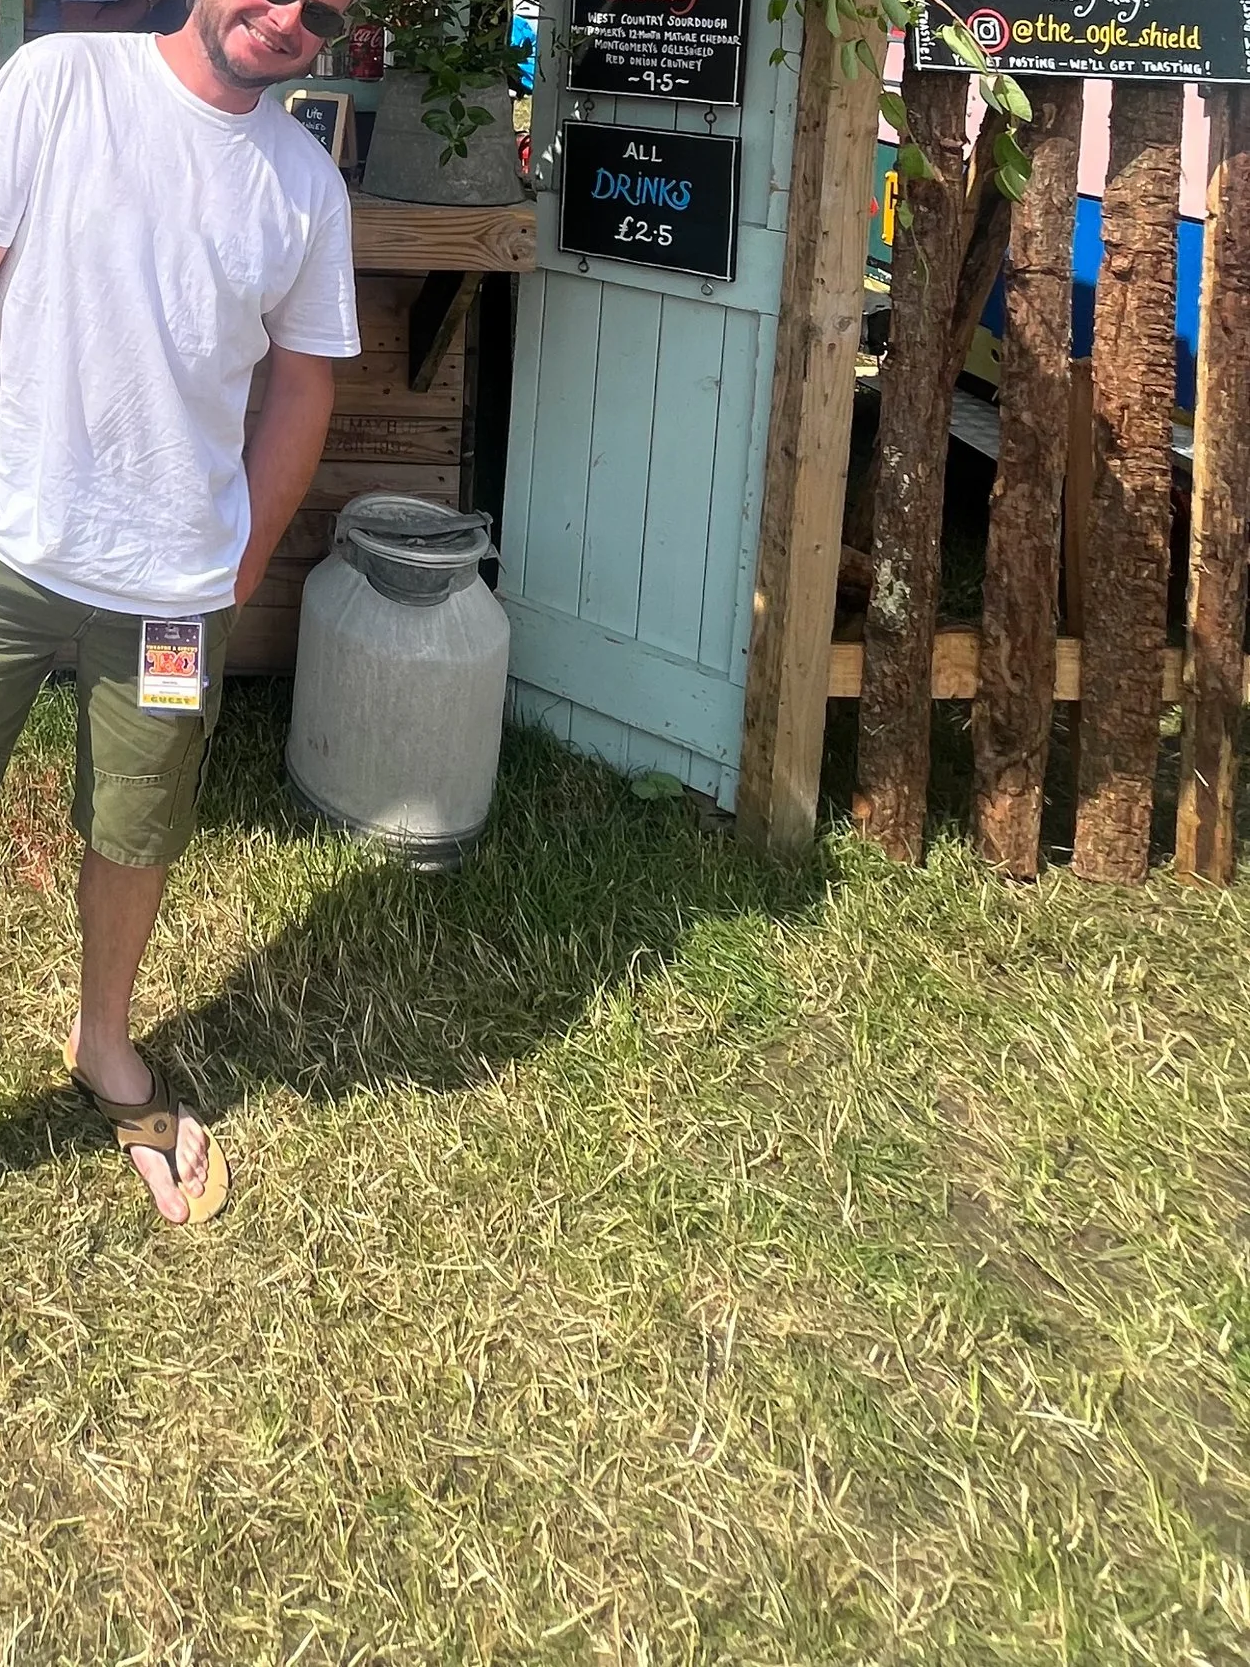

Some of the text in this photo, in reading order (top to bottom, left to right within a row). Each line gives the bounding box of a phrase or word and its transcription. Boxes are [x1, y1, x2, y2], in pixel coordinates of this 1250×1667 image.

[587, 12, 727, 29] WEST COUNTRY SOURDOUGH
[664, 31, 697, 43] MATURE
[700, 34, 742, 46] CHEDDAR
[1012, 13, 1201, 54] @the_ogle_shield
[605, 53, 625, 65] RED
[660, 57, 703, 72] CHUTNEY
[1109, 59, 1135, 72] GET
[622, 141, 663, 163] ALL
[614, 216, 673, 247] £2.5
